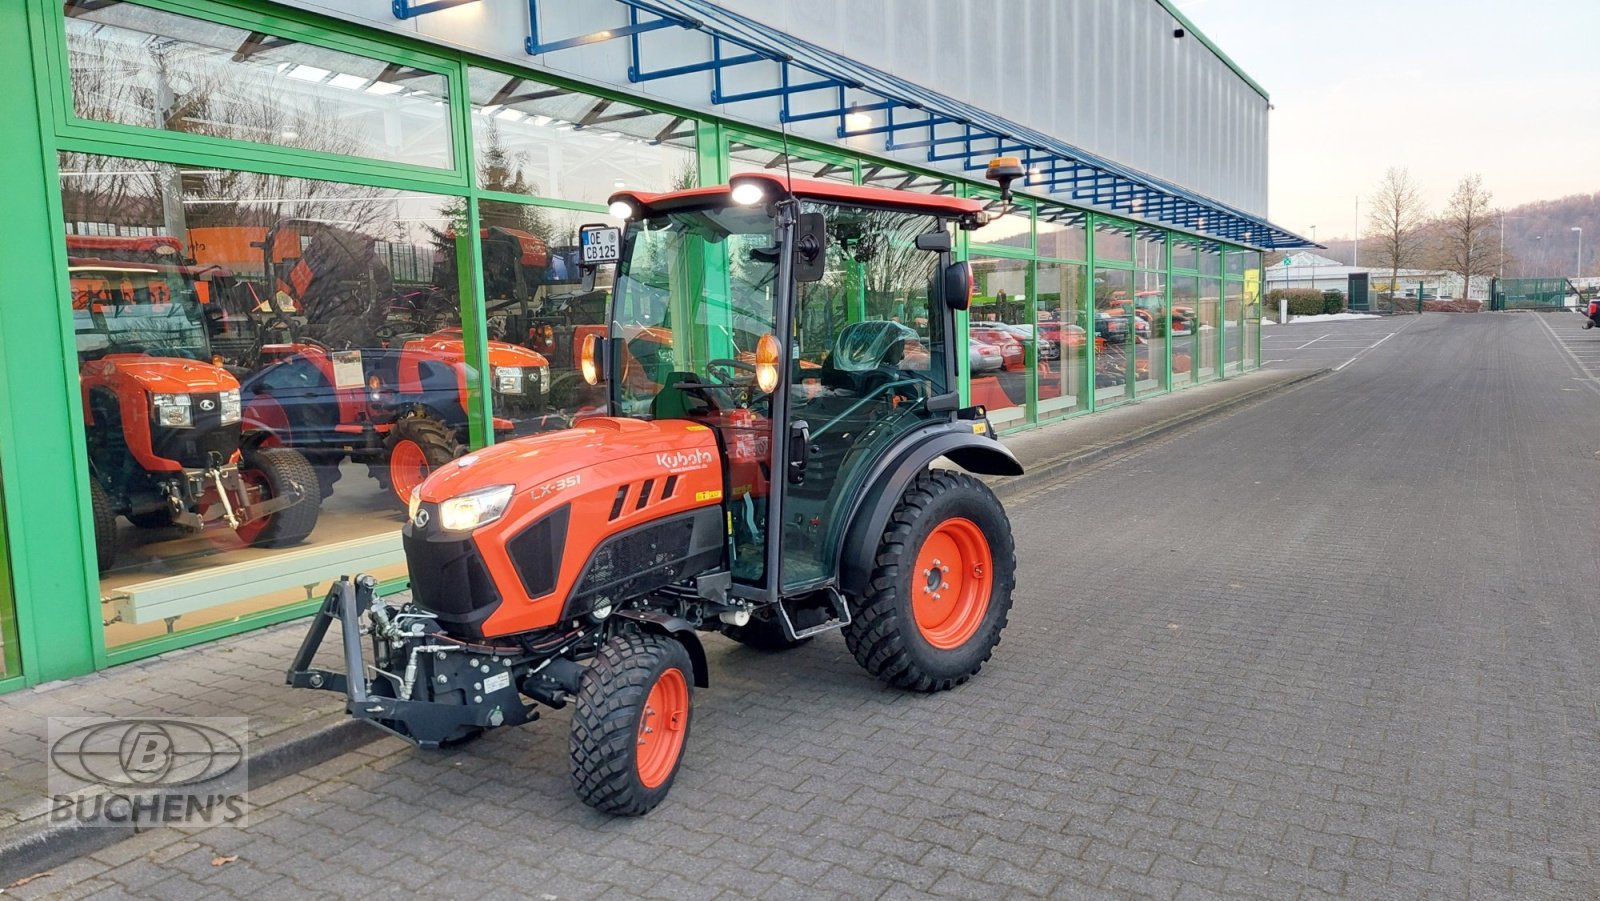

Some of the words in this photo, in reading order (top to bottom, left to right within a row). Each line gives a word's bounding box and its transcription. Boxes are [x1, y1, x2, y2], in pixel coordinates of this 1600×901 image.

[590, 232, 601, 245] OE
[655, 448, 713, 469] Kubota
[530, 474, 581, 501] LX-351
